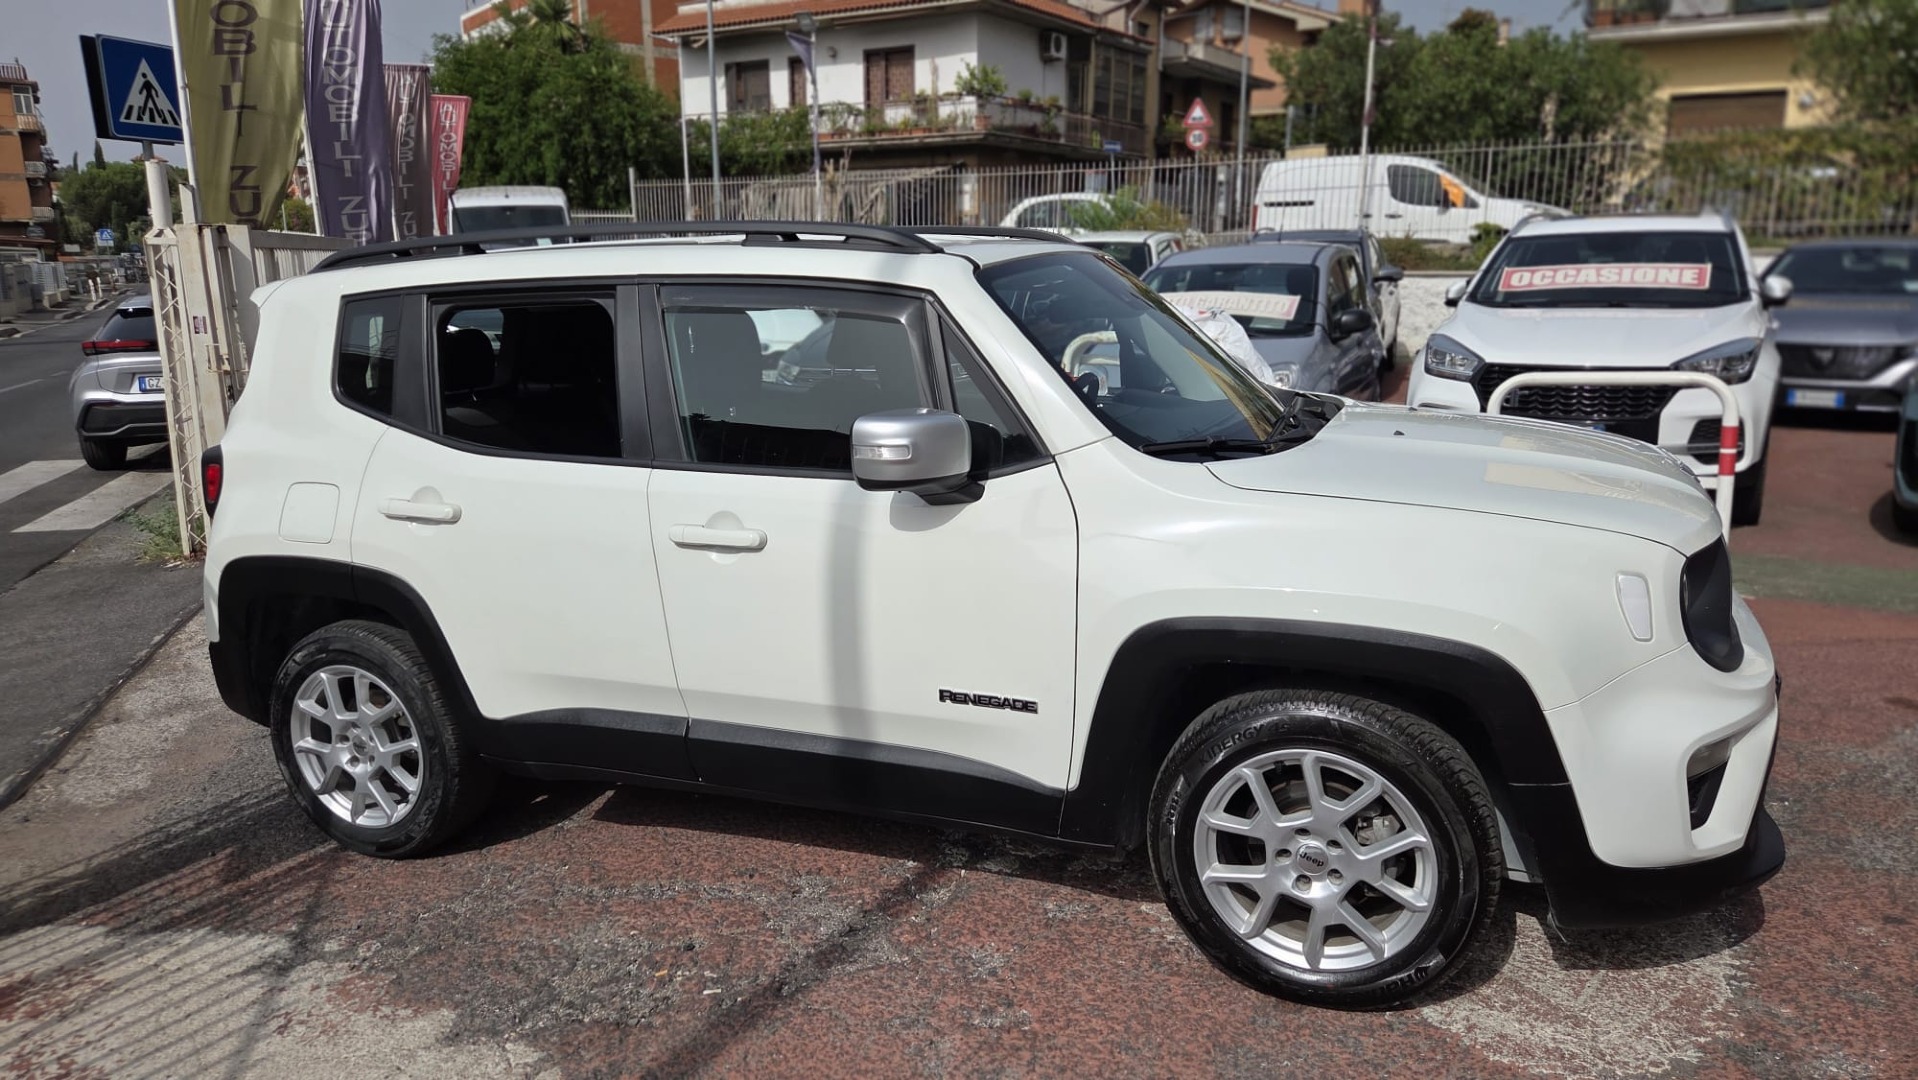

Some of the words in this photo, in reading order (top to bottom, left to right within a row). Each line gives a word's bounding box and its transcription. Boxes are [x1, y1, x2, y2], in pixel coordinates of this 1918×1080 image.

[1509, 267, 1701, 287] OCCASIONE
[938, 688, 1039, 715] RENEGADE
[1299, 851, 1325, 868] Jeep
